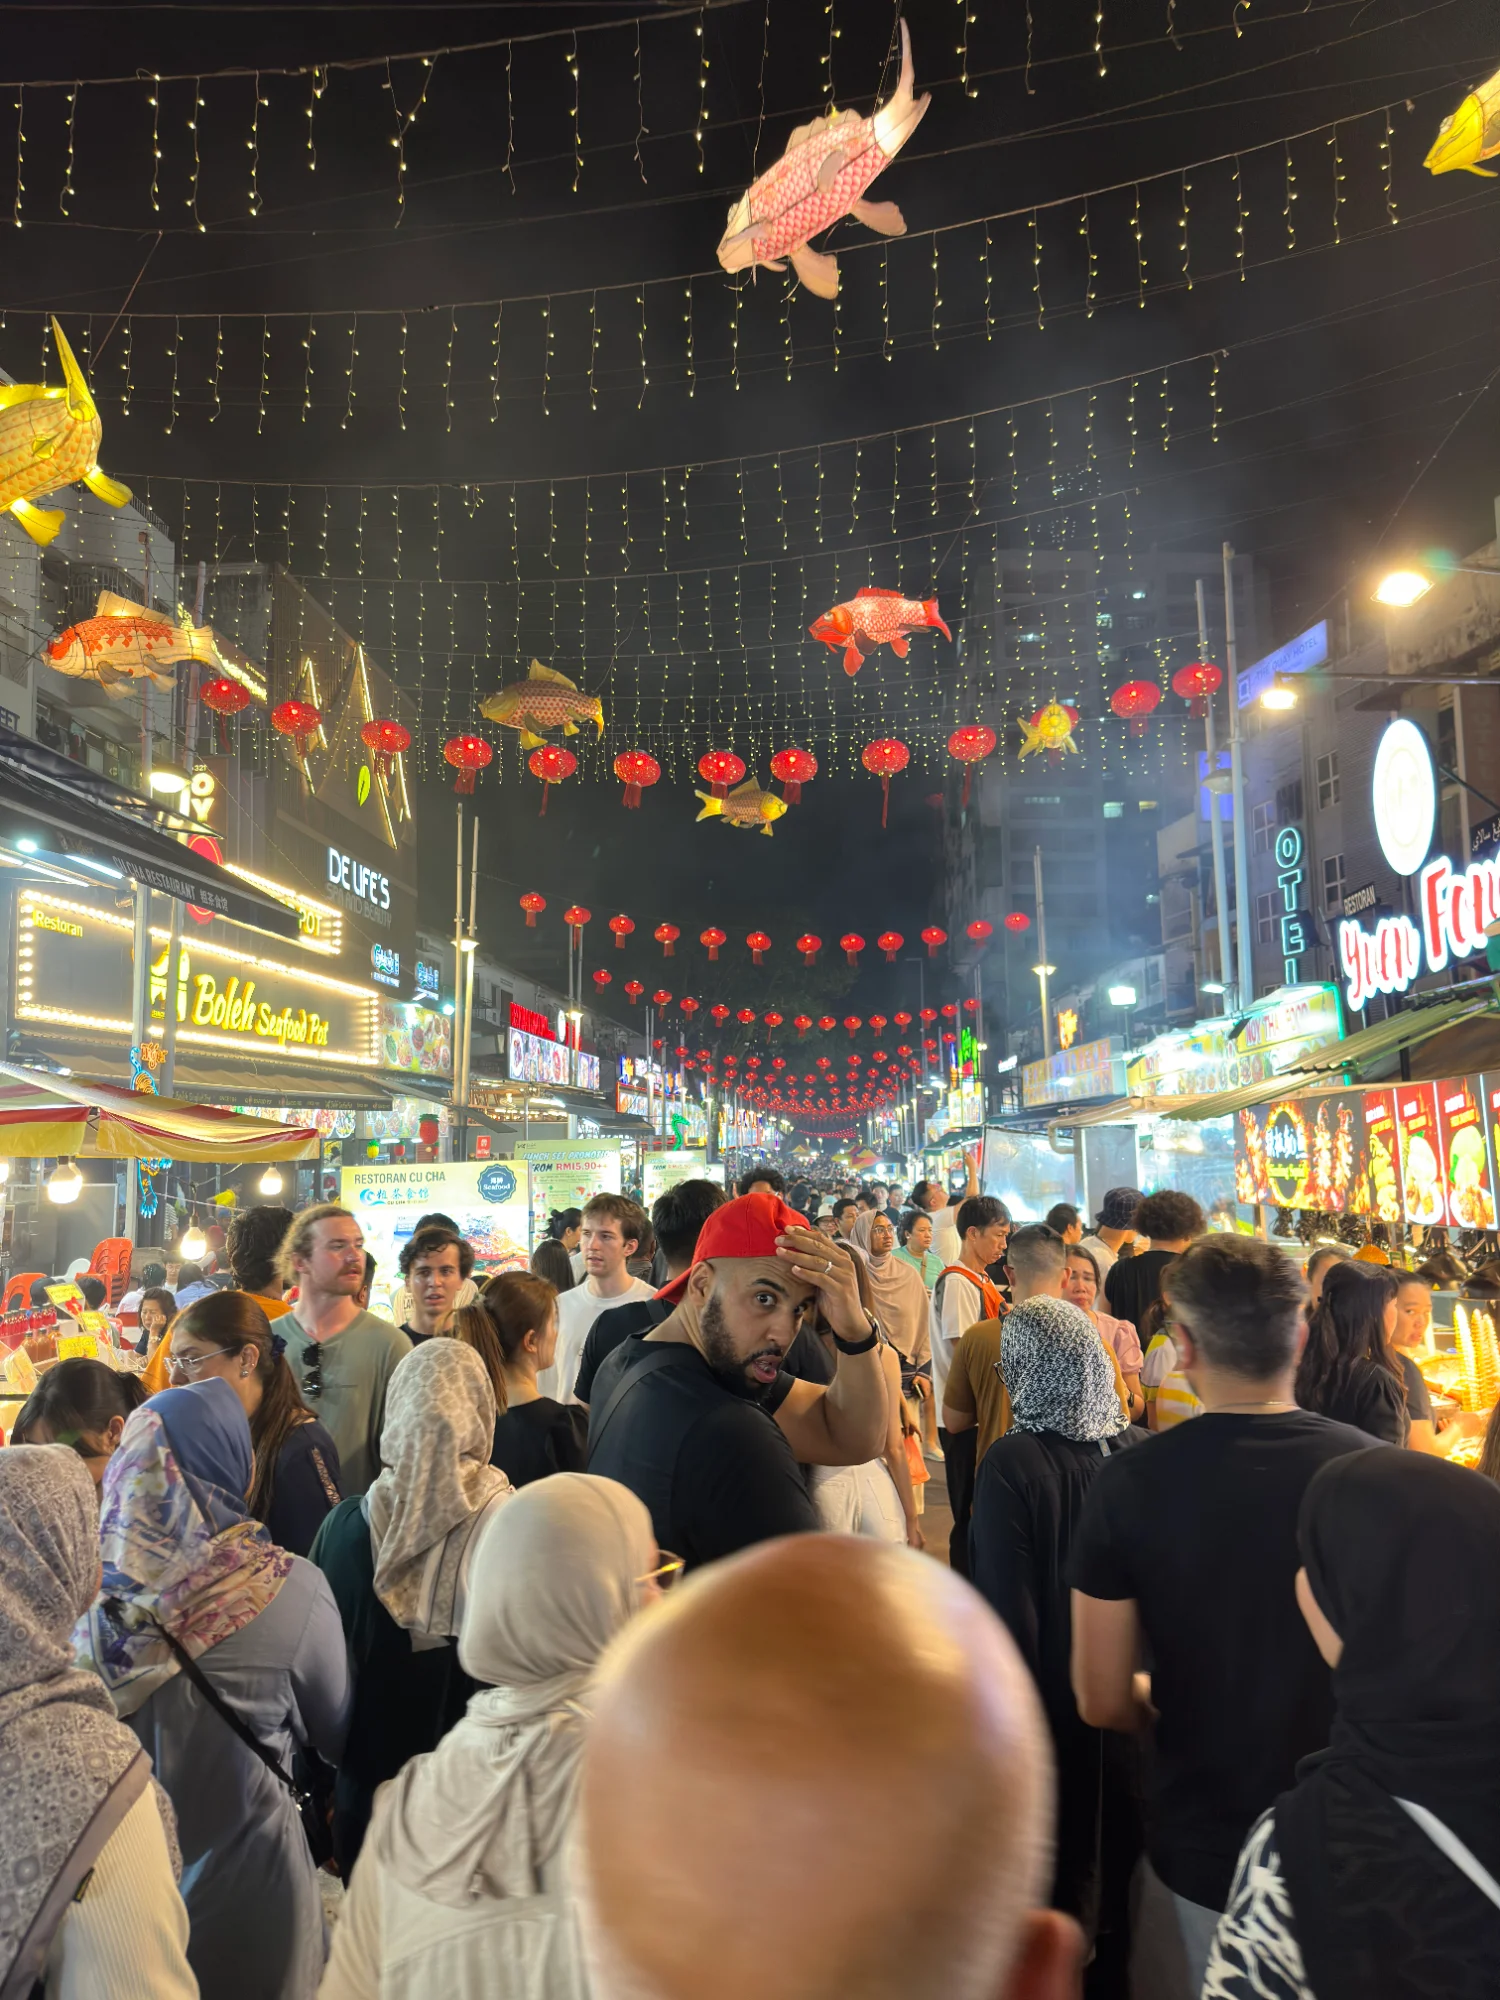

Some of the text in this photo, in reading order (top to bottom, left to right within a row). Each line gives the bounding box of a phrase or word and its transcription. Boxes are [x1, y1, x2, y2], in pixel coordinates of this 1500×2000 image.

[1293, 636, 1318, 658] HOTEL
[112, 855, 196, 900] CU CHA RESTAURANT
[328, 846, 391, 910] DE LIFE'S
[325, 882, 392, 931] SPA AND BEAUTY
[1344, 884, 1375, 916] RESTORAN
[33, 909, 83, 938] Restoran
[299, 908, 323, 937] POT
[193, 974, 329, 1046] Boleh Seafood Pot
[522, 1152, 549, 1160] LUNCH
[551, 1151, 567, 1160] SET
[531, 1163, 553, 1173] ROM
[354, 1171, 446, 1185] RESTORAN CU CHA
[483, 1182, 511, 1191] Seafood
